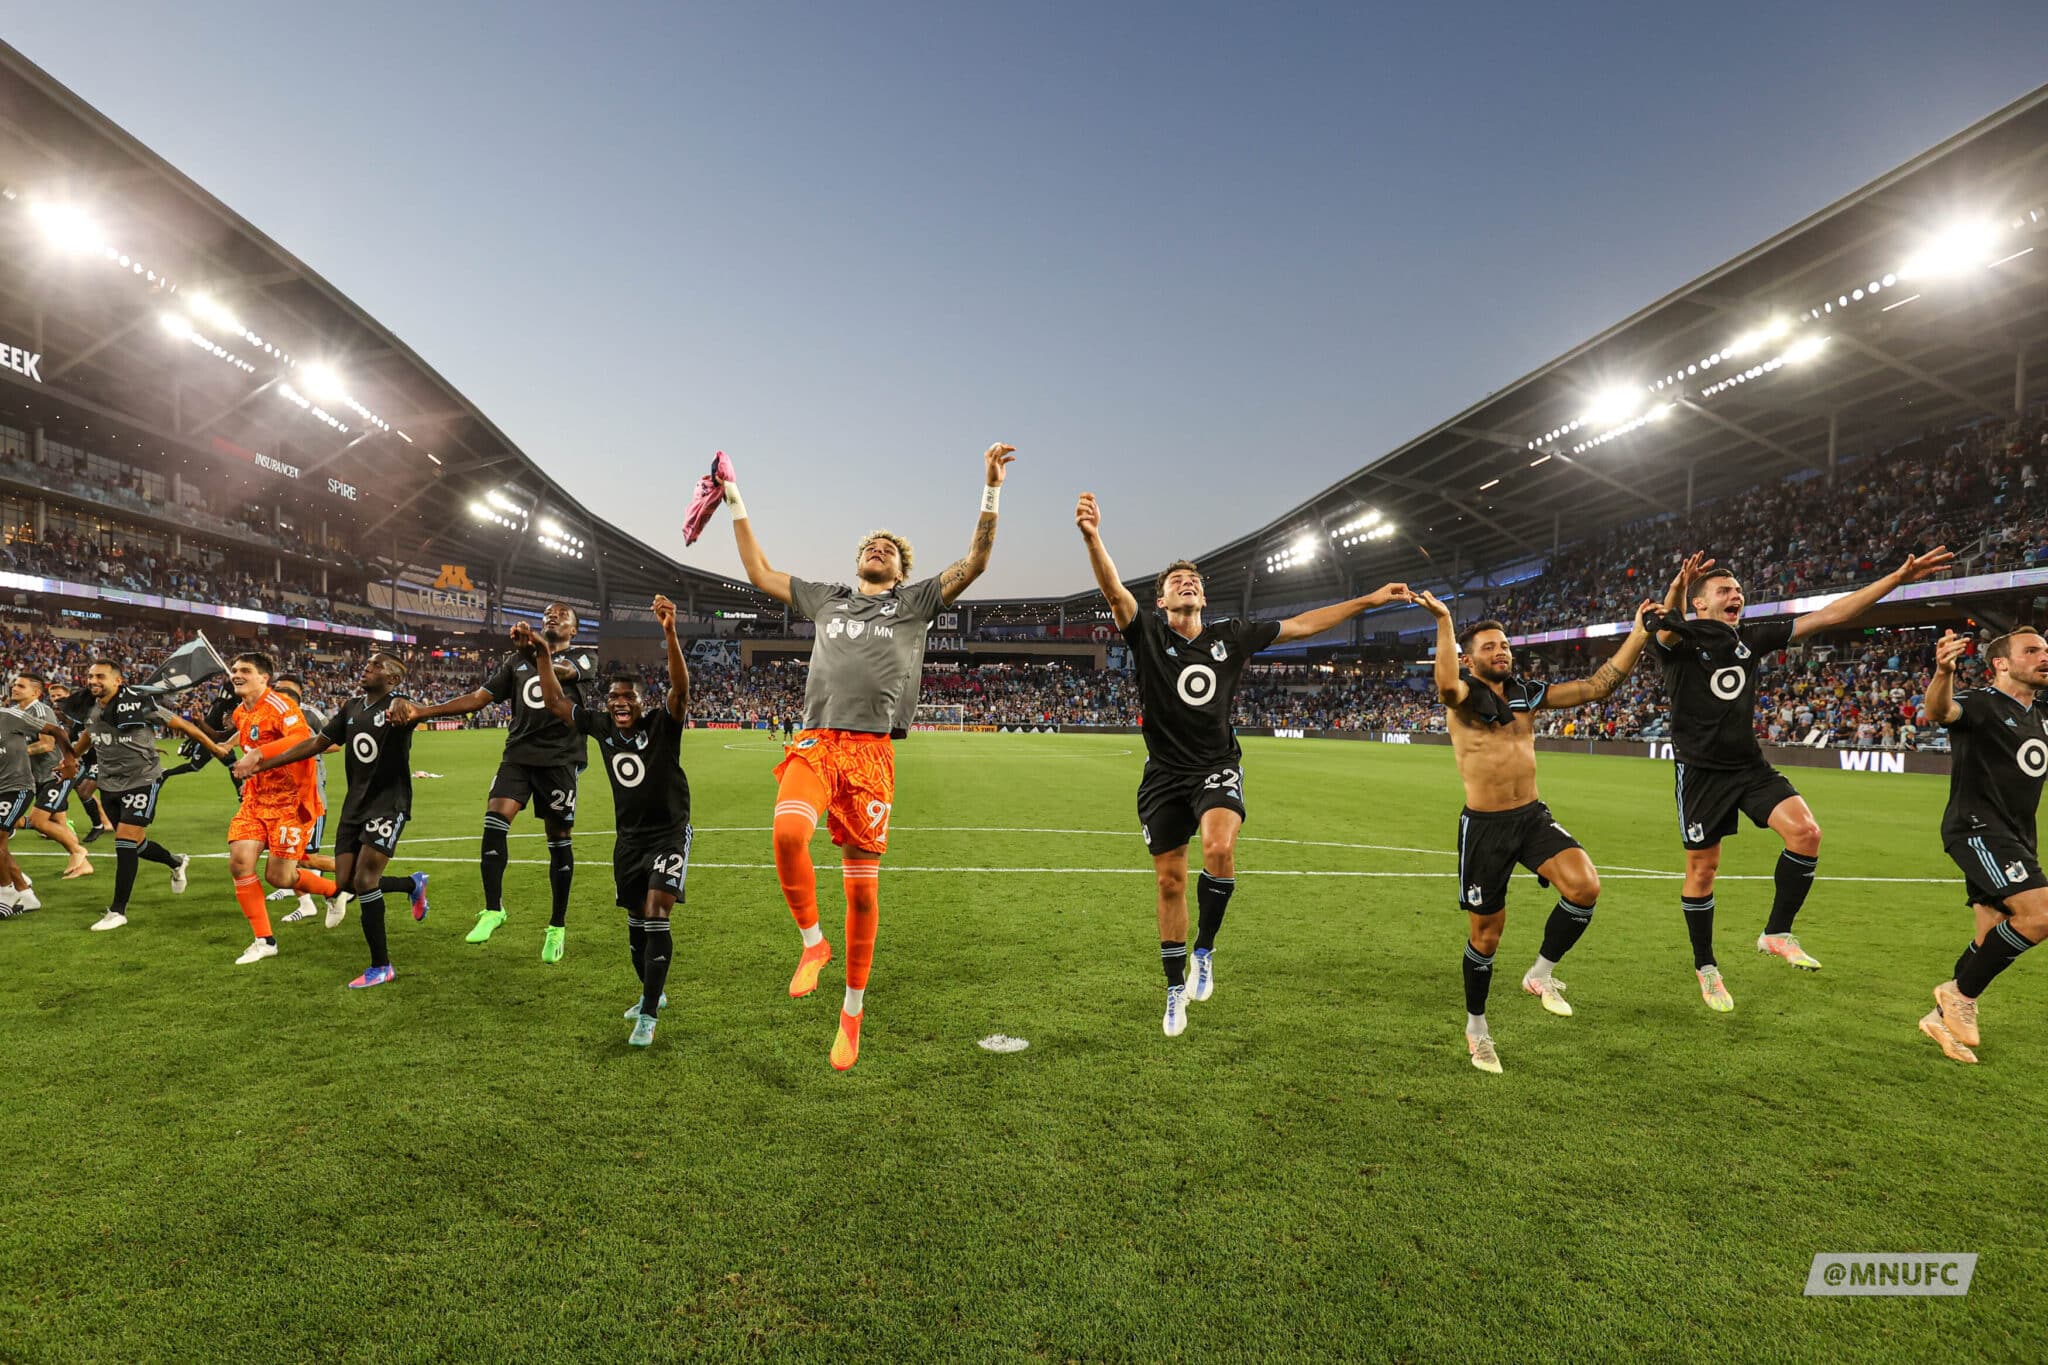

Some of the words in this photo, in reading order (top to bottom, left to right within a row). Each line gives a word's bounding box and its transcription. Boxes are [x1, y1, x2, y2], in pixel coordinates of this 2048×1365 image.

[327, 478, 357, 501] SPIRE
[419, 590, 488, 609] HEALTH
[874, 626, 894, 638] MN
[928, 637, 968, 651] HALL
[1274, 729, 1304, 739] WIN
[1839, 750, 1905, 773] WIN
[550, 789, 577, 811] 24
[280, 826, 301, 846] 13
[653, 853, 684, 878] 42
